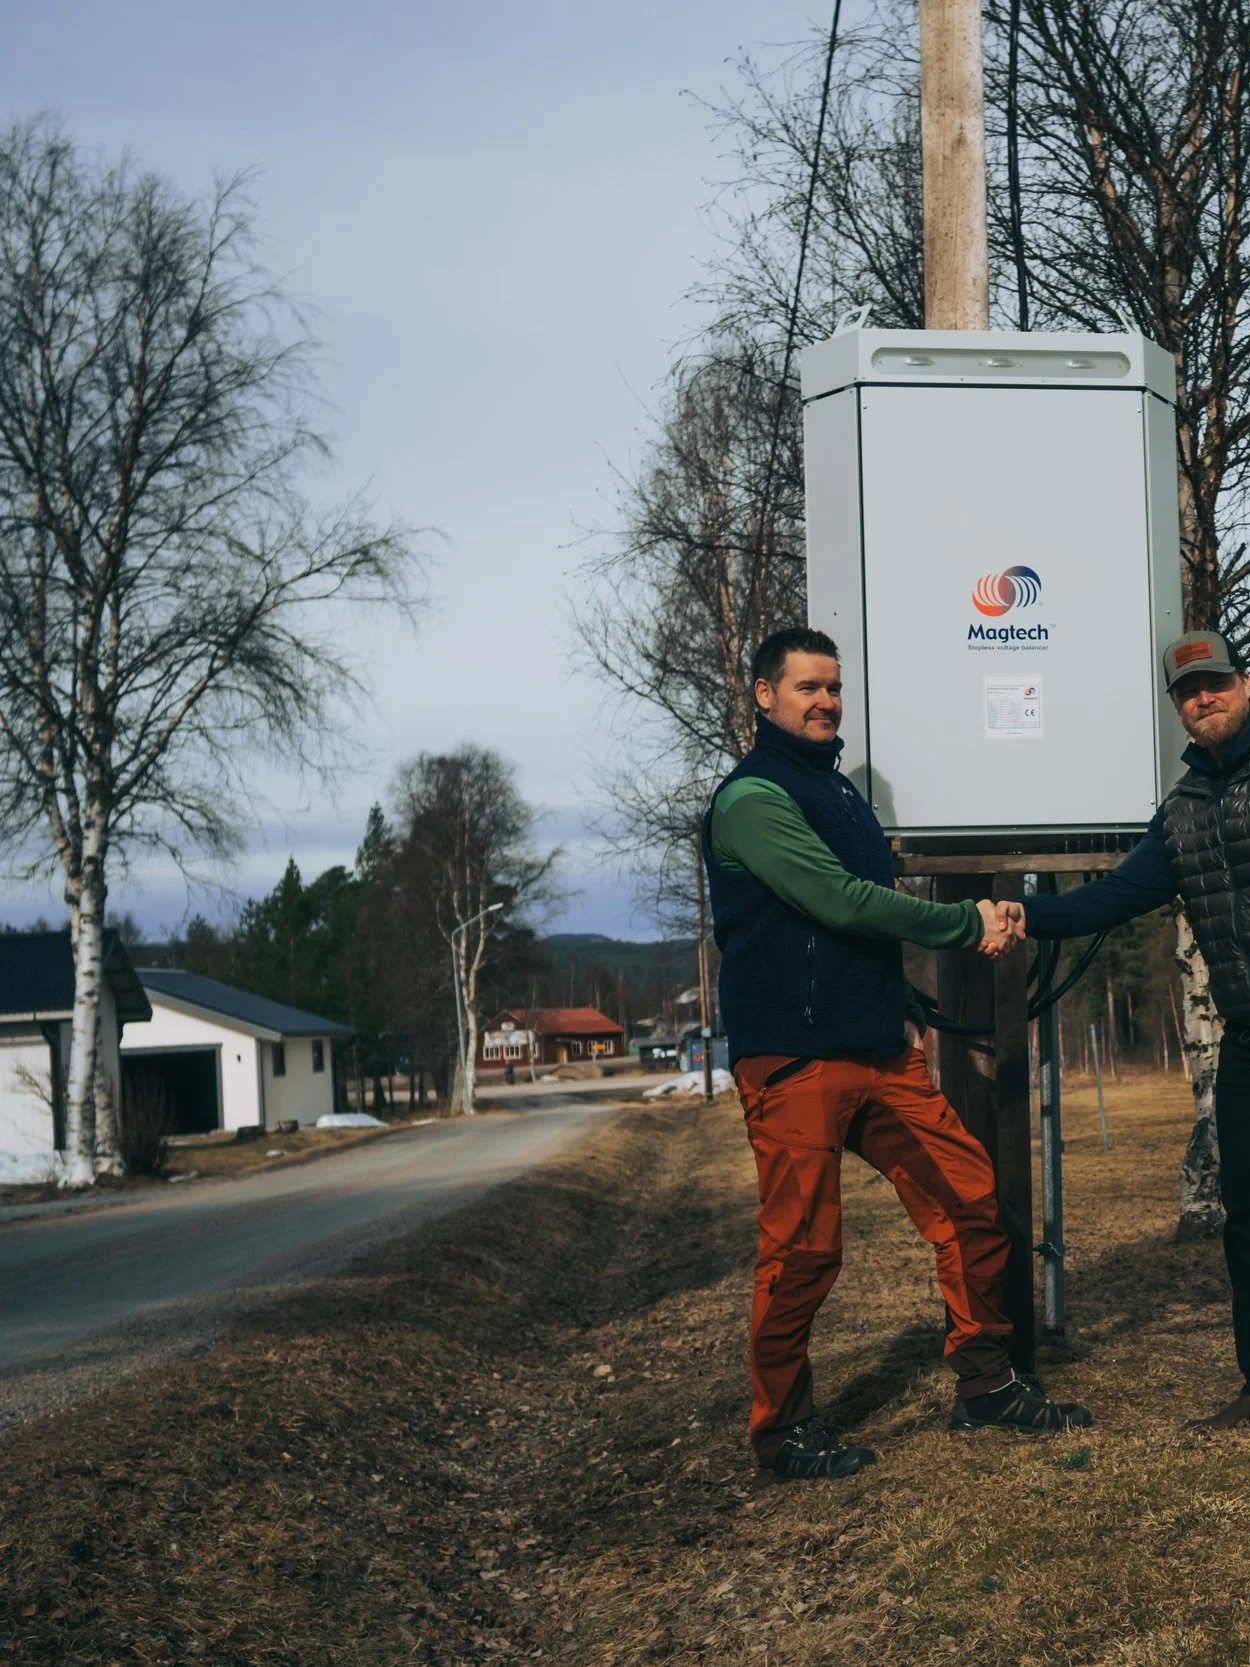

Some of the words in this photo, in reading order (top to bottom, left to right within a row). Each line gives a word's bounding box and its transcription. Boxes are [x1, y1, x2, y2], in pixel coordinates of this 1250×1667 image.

[967, 623, 1048, 643] Magtech
[967, 644, 995, 652] Stepless
[997, 644, 1020, 652] voltage
